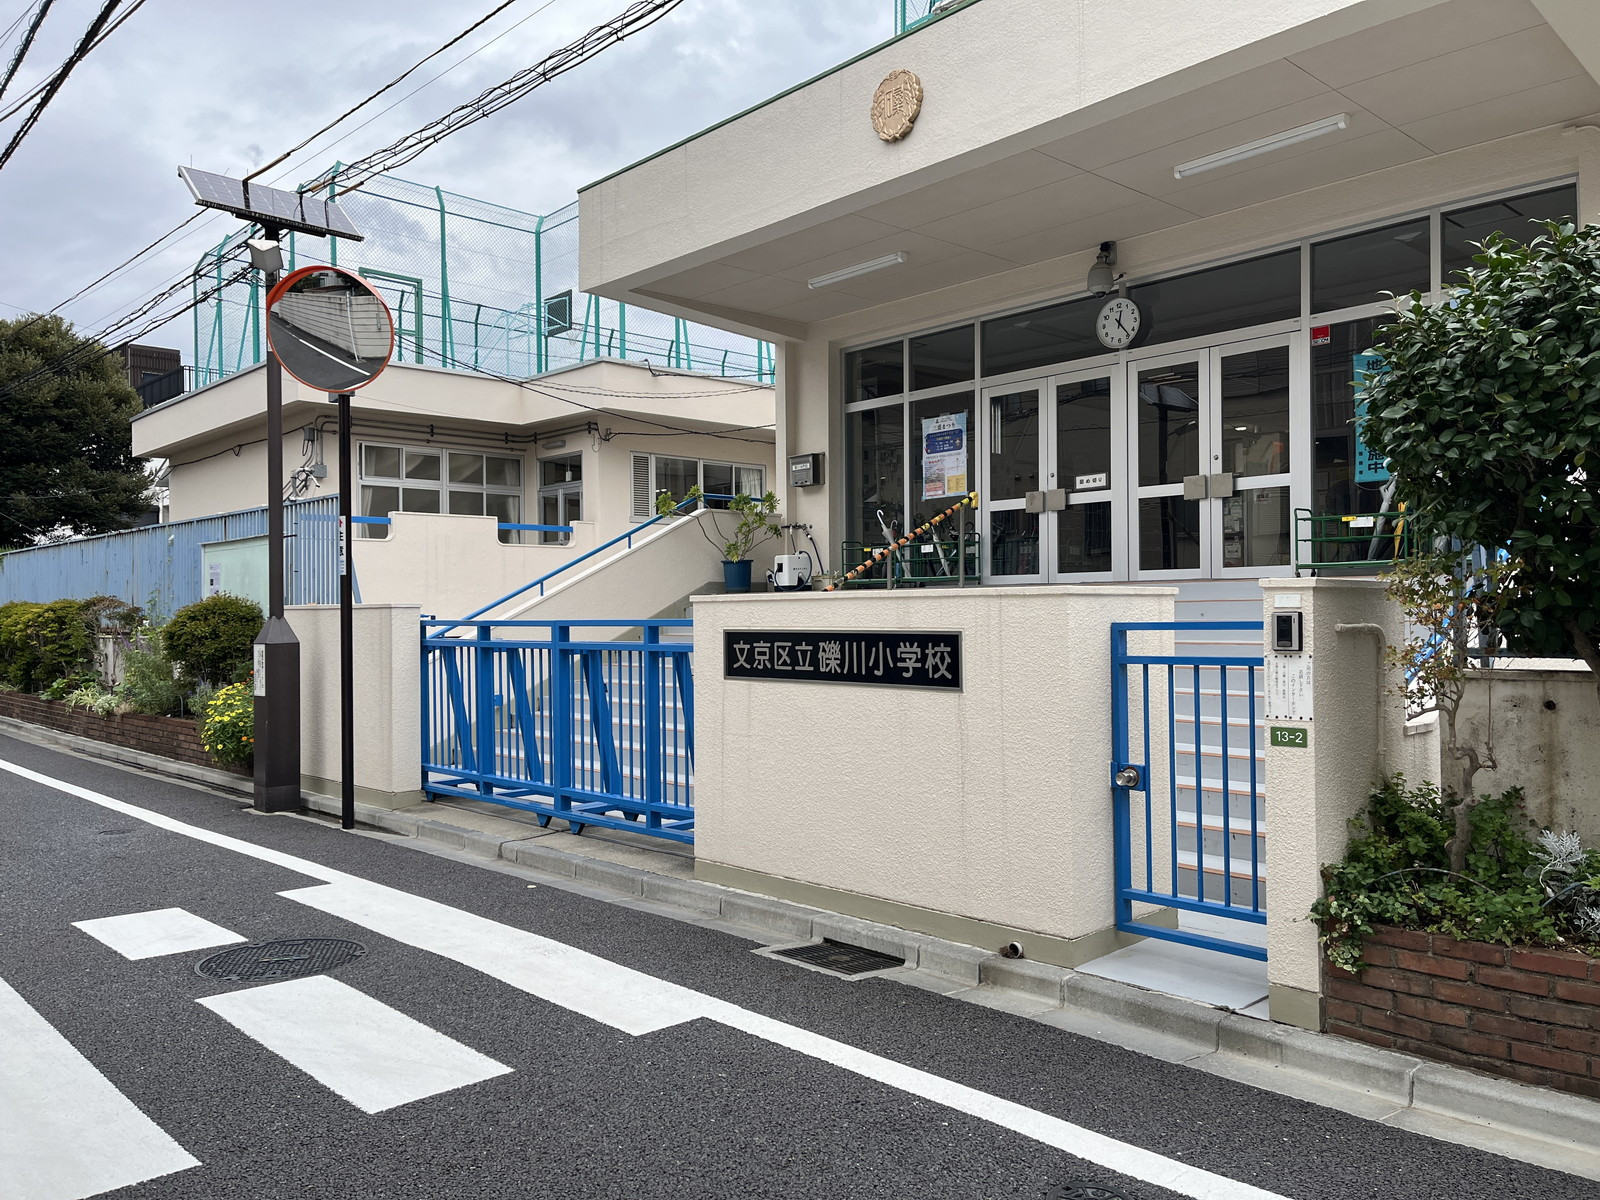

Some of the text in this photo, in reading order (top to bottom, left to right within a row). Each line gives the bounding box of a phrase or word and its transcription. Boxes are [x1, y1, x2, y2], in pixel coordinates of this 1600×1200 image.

[733, 640, 952, 679] 文京区立礫川小学校
[1276, 731, 1303, 743] 13-2
